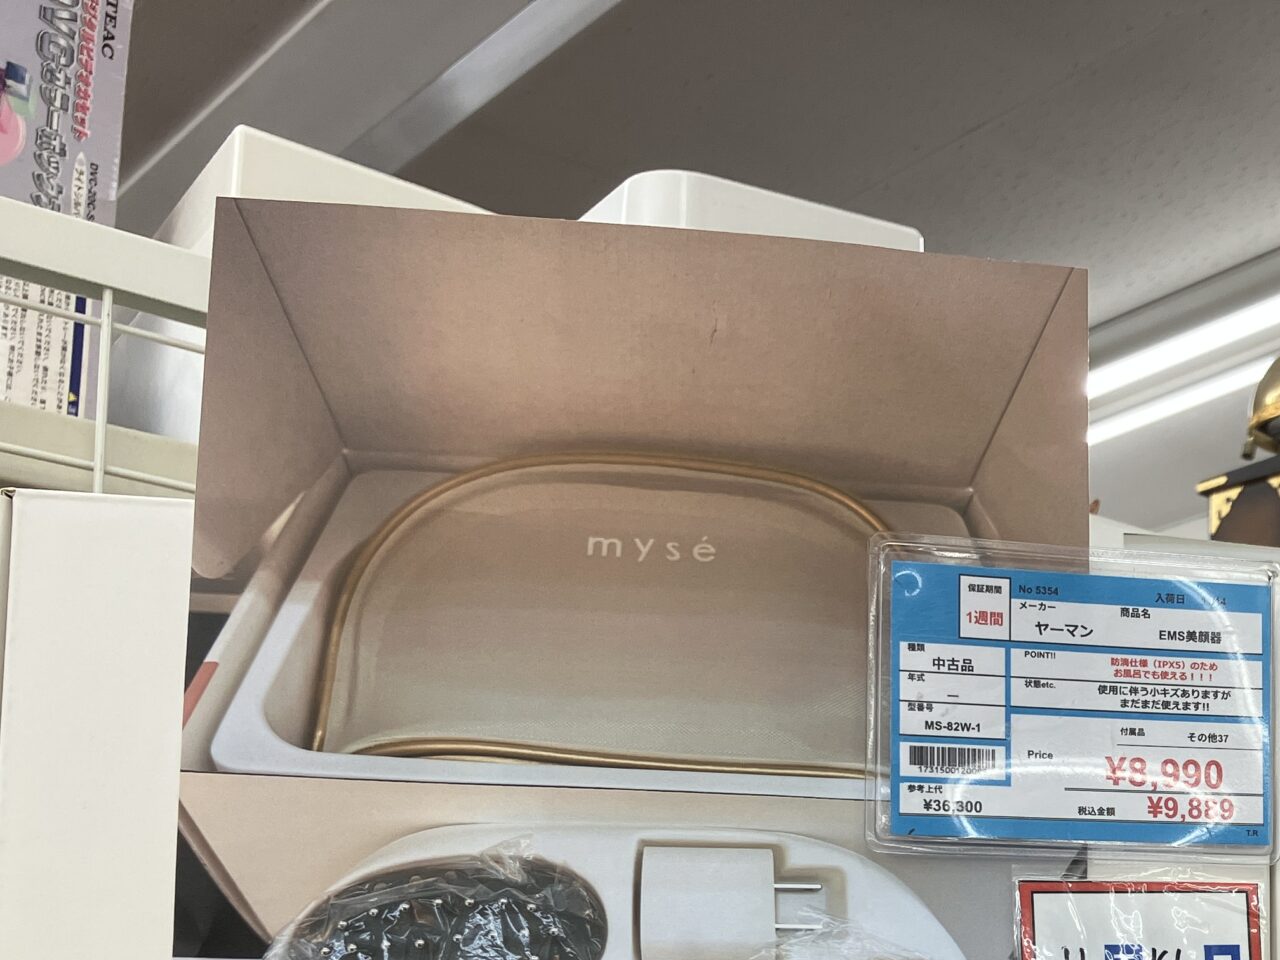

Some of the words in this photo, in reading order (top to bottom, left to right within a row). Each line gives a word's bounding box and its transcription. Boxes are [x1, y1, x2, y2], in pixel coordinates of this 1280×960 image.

[586, 535, 716, 563] mysé
[968, 583, 1002, 594] 保証期間
[1018, 585, 1033, 594] No
[1036, 586, 1059, 596] 5354
[1155, 593, 1185, 604] 入荷日
[1019, 601, 1056, 611] メーカー
[966, 611, 1004, 627] 1週間
[1120, 607, 1151, 619] 商品名
[1035, 621, 1094, 639] ヤーマン
[1159, 630, 1222, 645] EMS美顔器
[907, 642, 925, 652] 種類
[1024, 650, 1056, 660] POINT!!
[932, 656, 975, 673] 中古品
[907, 673, 925, 682] 年式
[1097, 684, 1232, 701] 使用に伴う小キズありますが
[907, 702, 934, 713] 型番号
[924, 720, 981, 733] MS-82W-1
[1120, 727, 1146, 737] 付属品
[1187, 732, 1229, 744] その他37
[1027, 750, 1054, 760] Price
[1105, 756, 1224, 792] ¥8,990
[907, 784, 943, 794] 参考上代
[923, 798, 983, 815] ¥36,300
[1078, 806, 1116, 817] 税込金額
[1147, 796, 1235, 823] ¥9,889
